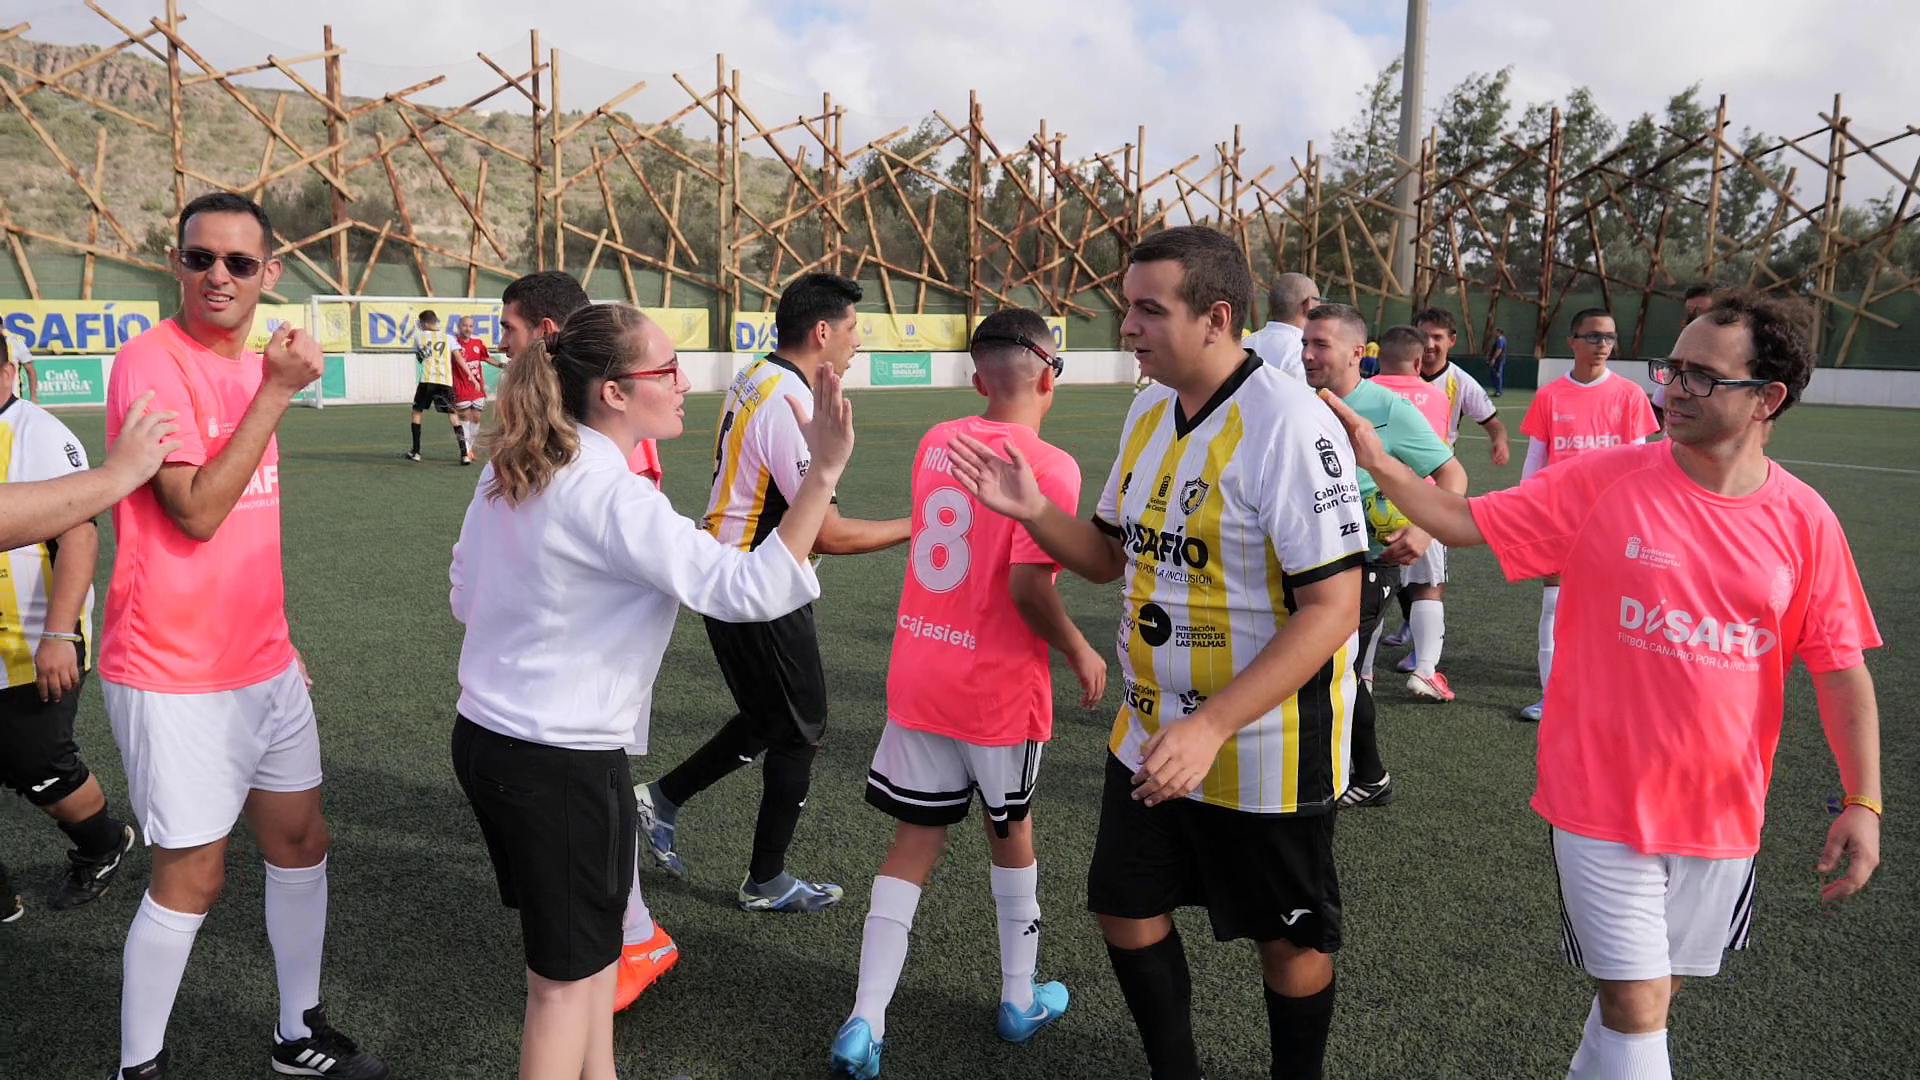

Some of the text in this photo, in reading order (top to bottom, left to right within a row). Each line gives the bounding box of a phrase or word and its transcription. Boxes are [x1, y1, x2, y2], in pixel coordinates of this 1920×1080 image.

[5, 303, 150, 348] SAFÍO
[1313, 499, 1339, 514] Gran
[912, 486, 974, 593] 8
[900, 614, 976, 650] cajasiete
[1176, 632, 1213, 640] PUERTOS
[1192, 640, 1226, 648] PALMAS
[1649, 642, 1694, 662] CANARIO
[1696, 654, 1716, 668] POR
[1717, 659, 1729, 670] LA
